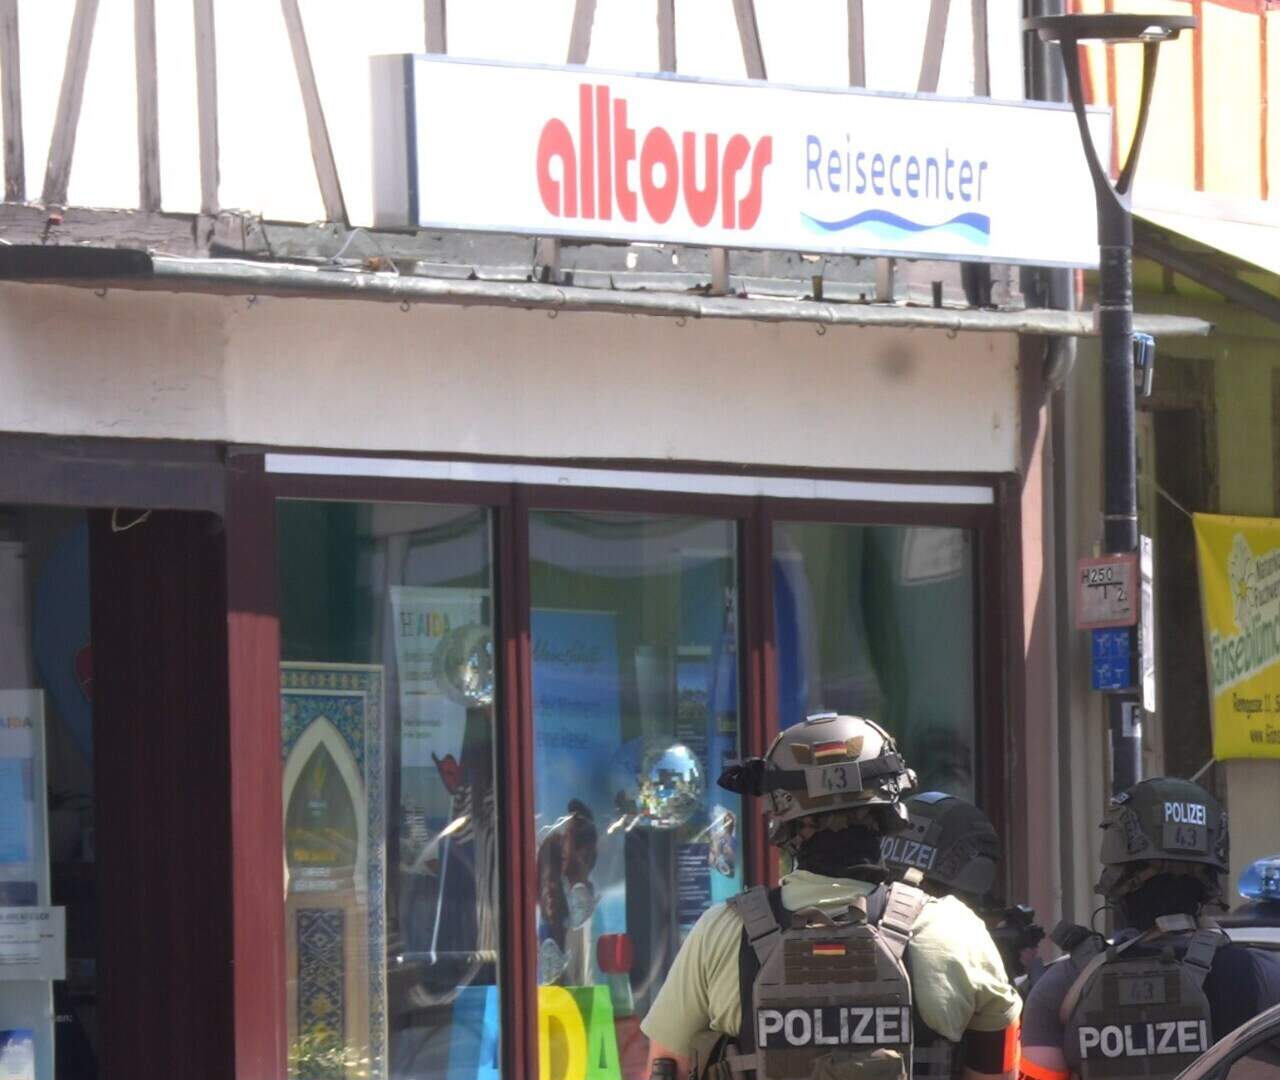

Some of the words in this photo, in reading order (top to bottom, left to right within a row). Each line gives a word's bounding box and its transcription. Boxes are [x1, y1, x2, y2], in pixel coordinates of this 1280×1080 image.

[536, 83, 772, 230] alltours
[806, 133, 988, 201] Reisecenter
[1165, 802, 1206, 826] POLIZEI
[880, 836, 938, 870] OLIZEI
[758, 1007, 910, 1047] POLIZEI
[1078, 1019, 1208, 1059] POLIZEI
